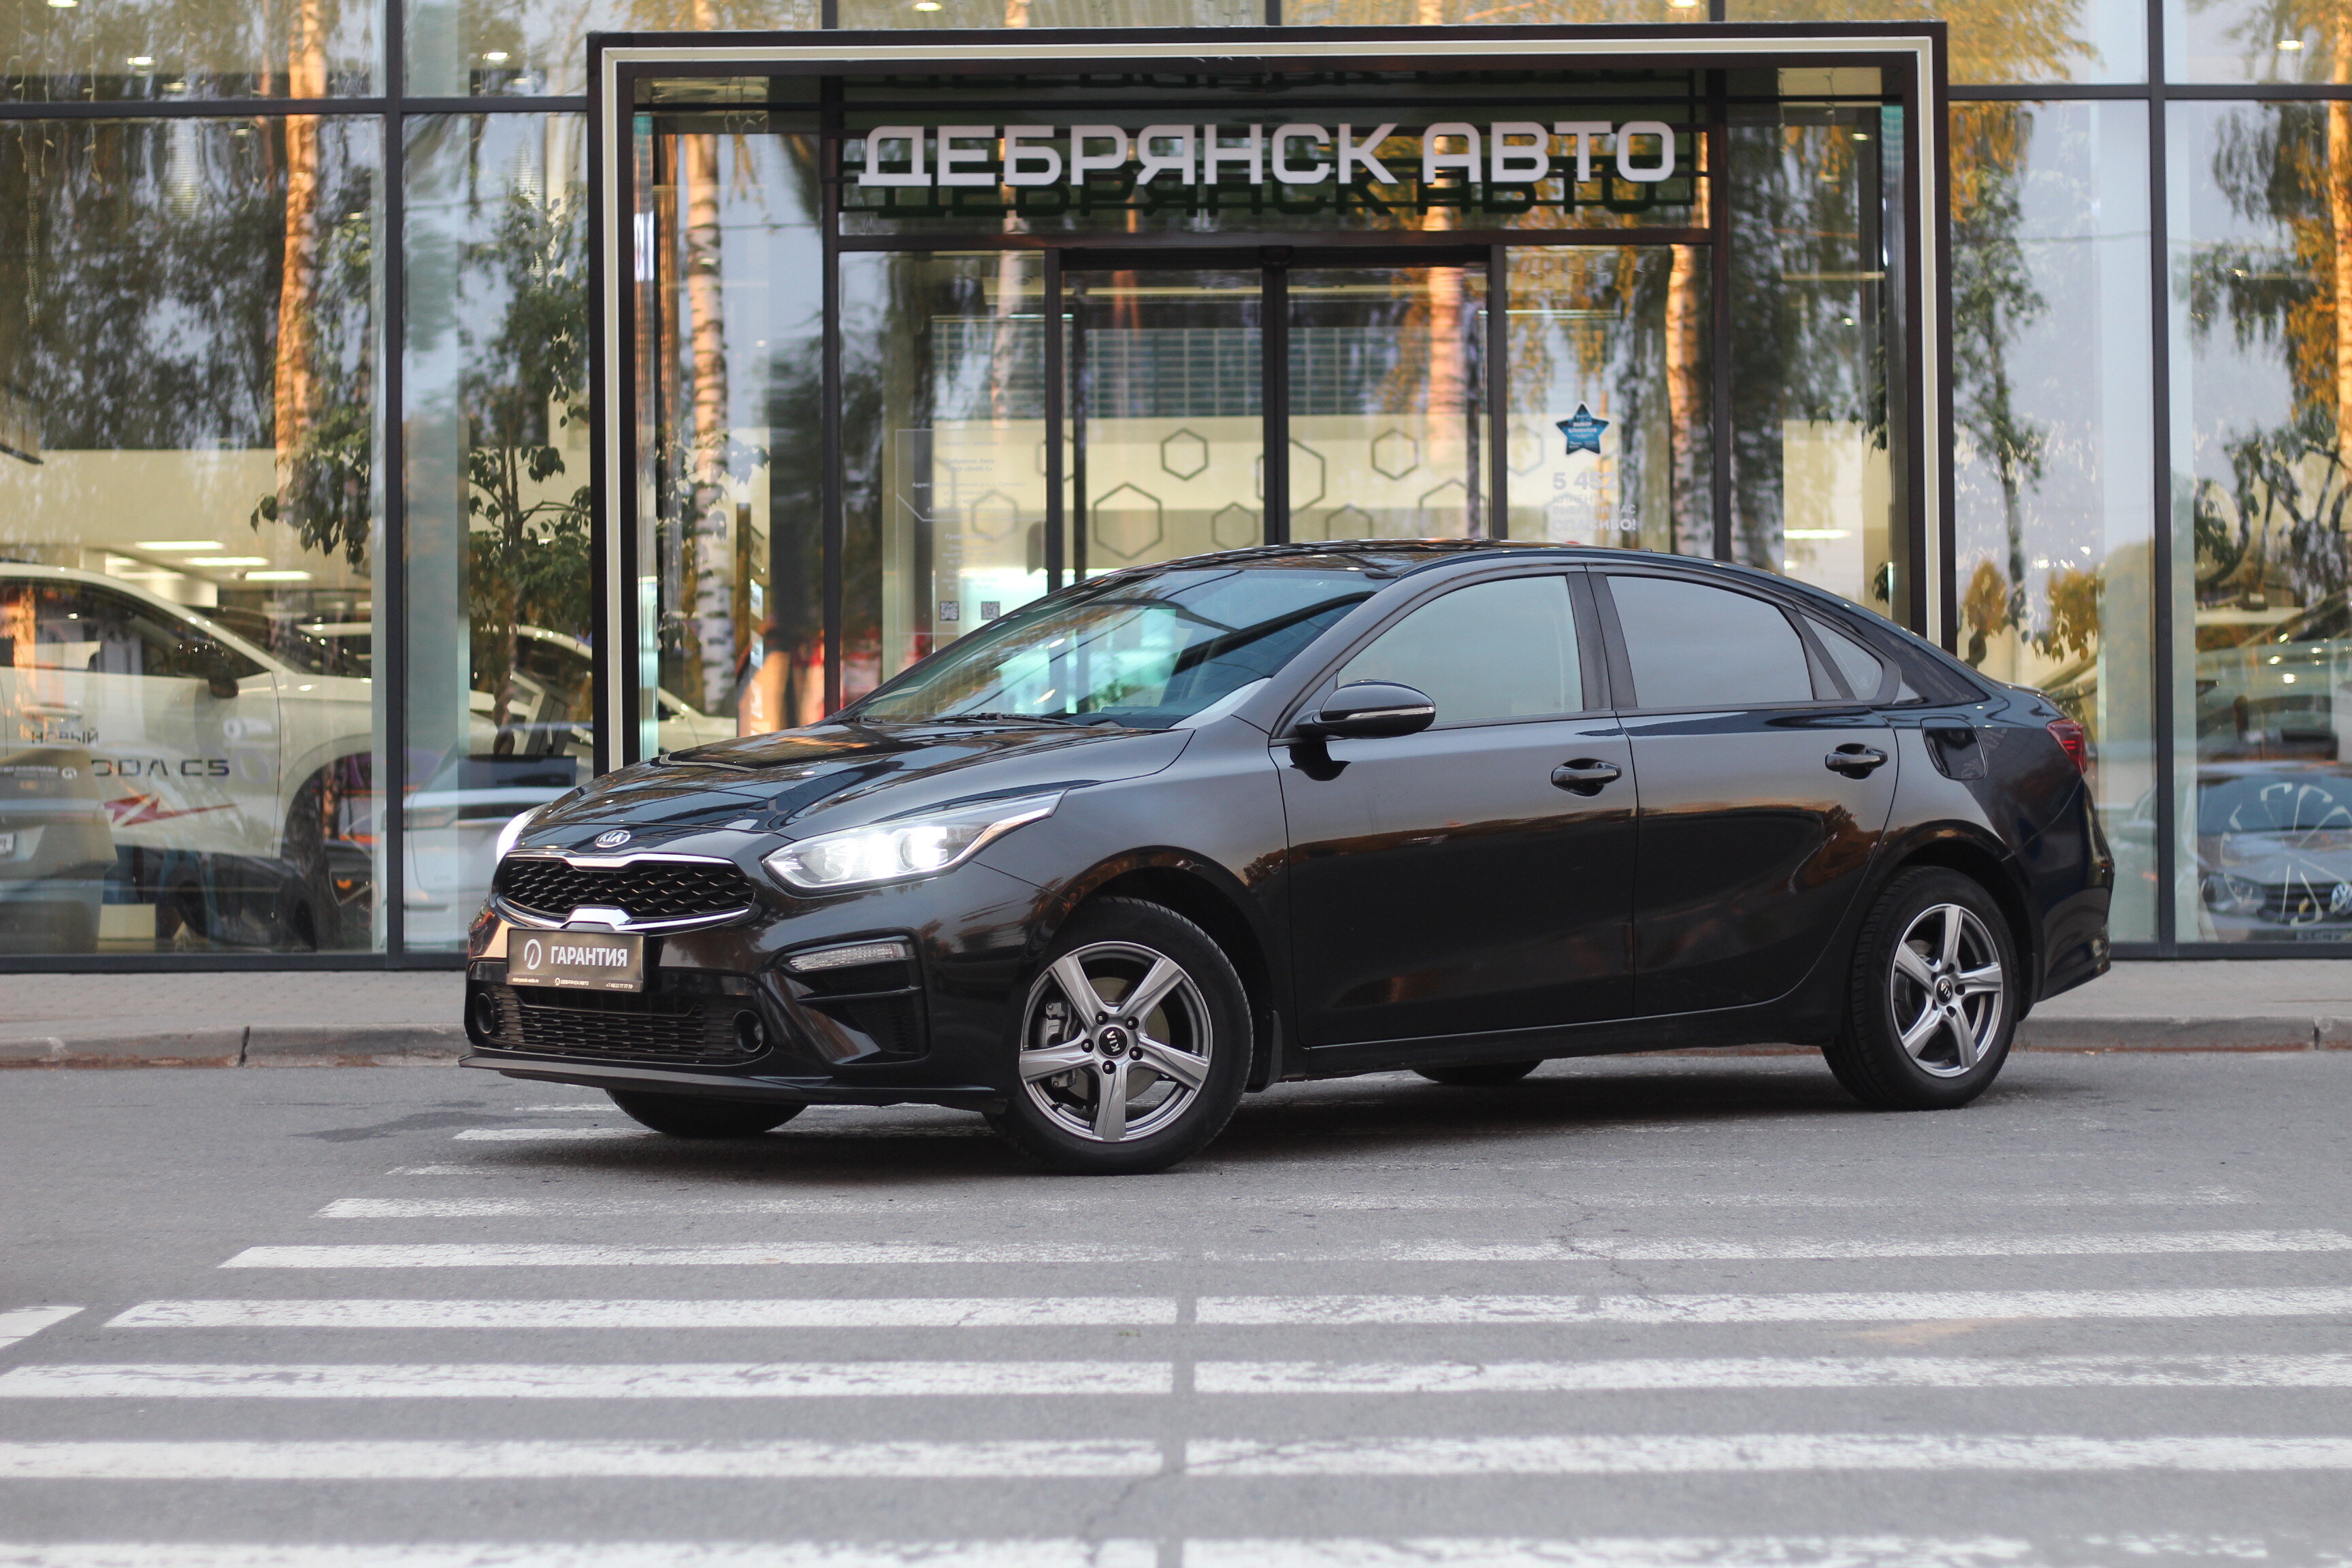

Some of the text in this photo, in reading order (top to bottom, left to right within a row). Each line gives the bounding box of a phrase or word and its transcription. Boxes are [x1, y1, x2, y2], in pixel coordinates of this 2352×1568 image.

[858, 120, 1676, 186] ДЕБРЯНСК АВТО
[1574, 471, 1618, 490] 452
[180, 759, 230, 777] C5
[597, 830, 627, 845] KIA
[550, 946, 627, 967] ГАРАНТИЯ
[1940, 982, 1952, 1000] KIA
[1107, 1030, 1120, 1053] KIA
